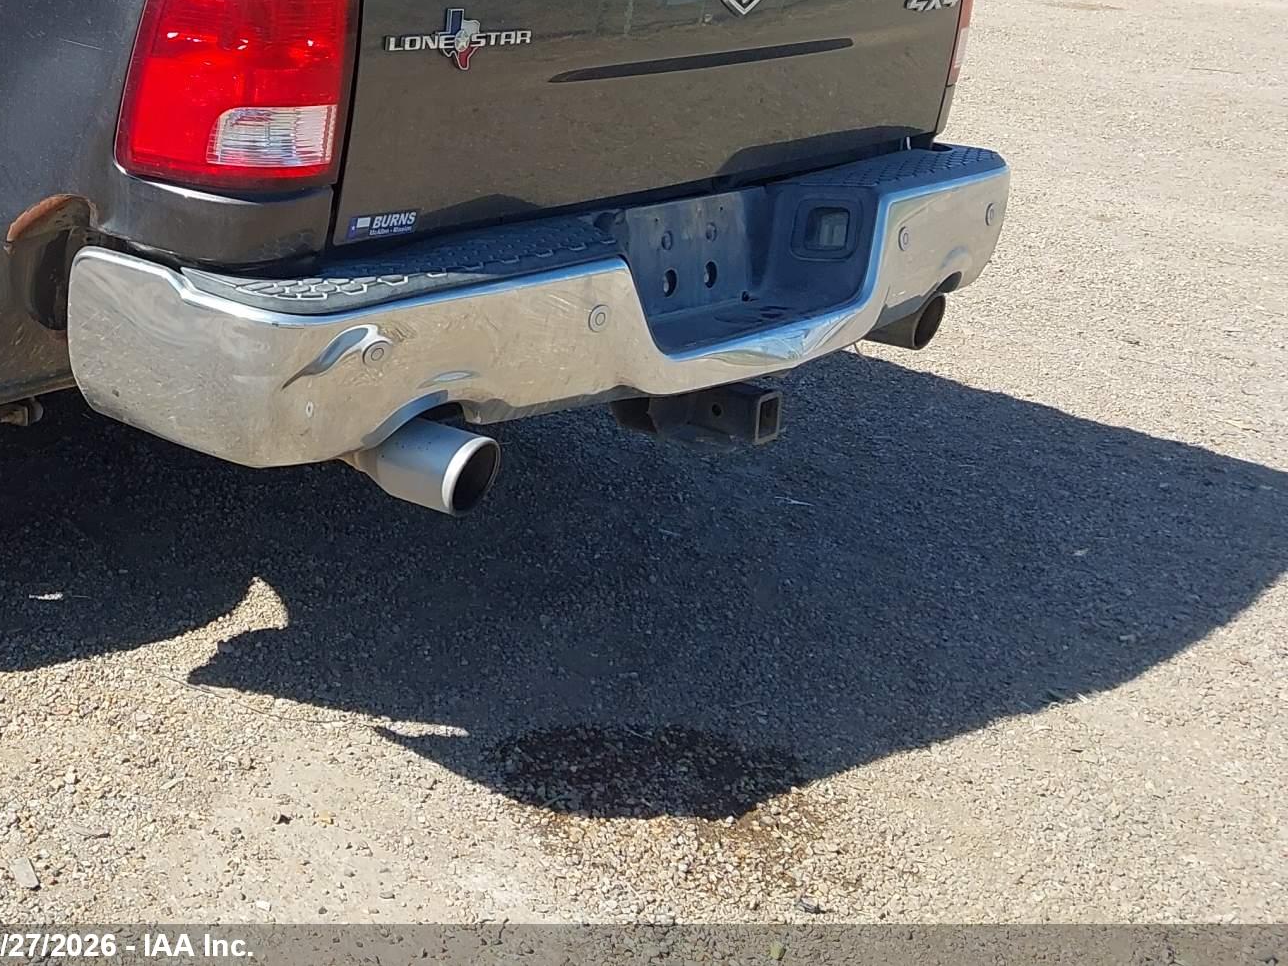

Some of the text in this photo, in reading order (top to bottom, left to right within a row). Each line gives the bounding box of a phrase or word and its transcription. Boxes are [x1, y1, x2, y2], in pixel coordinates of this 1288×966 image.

[383, 30, 532, 51] LONE STAR
[372, 211, 417, 229] BURNS
